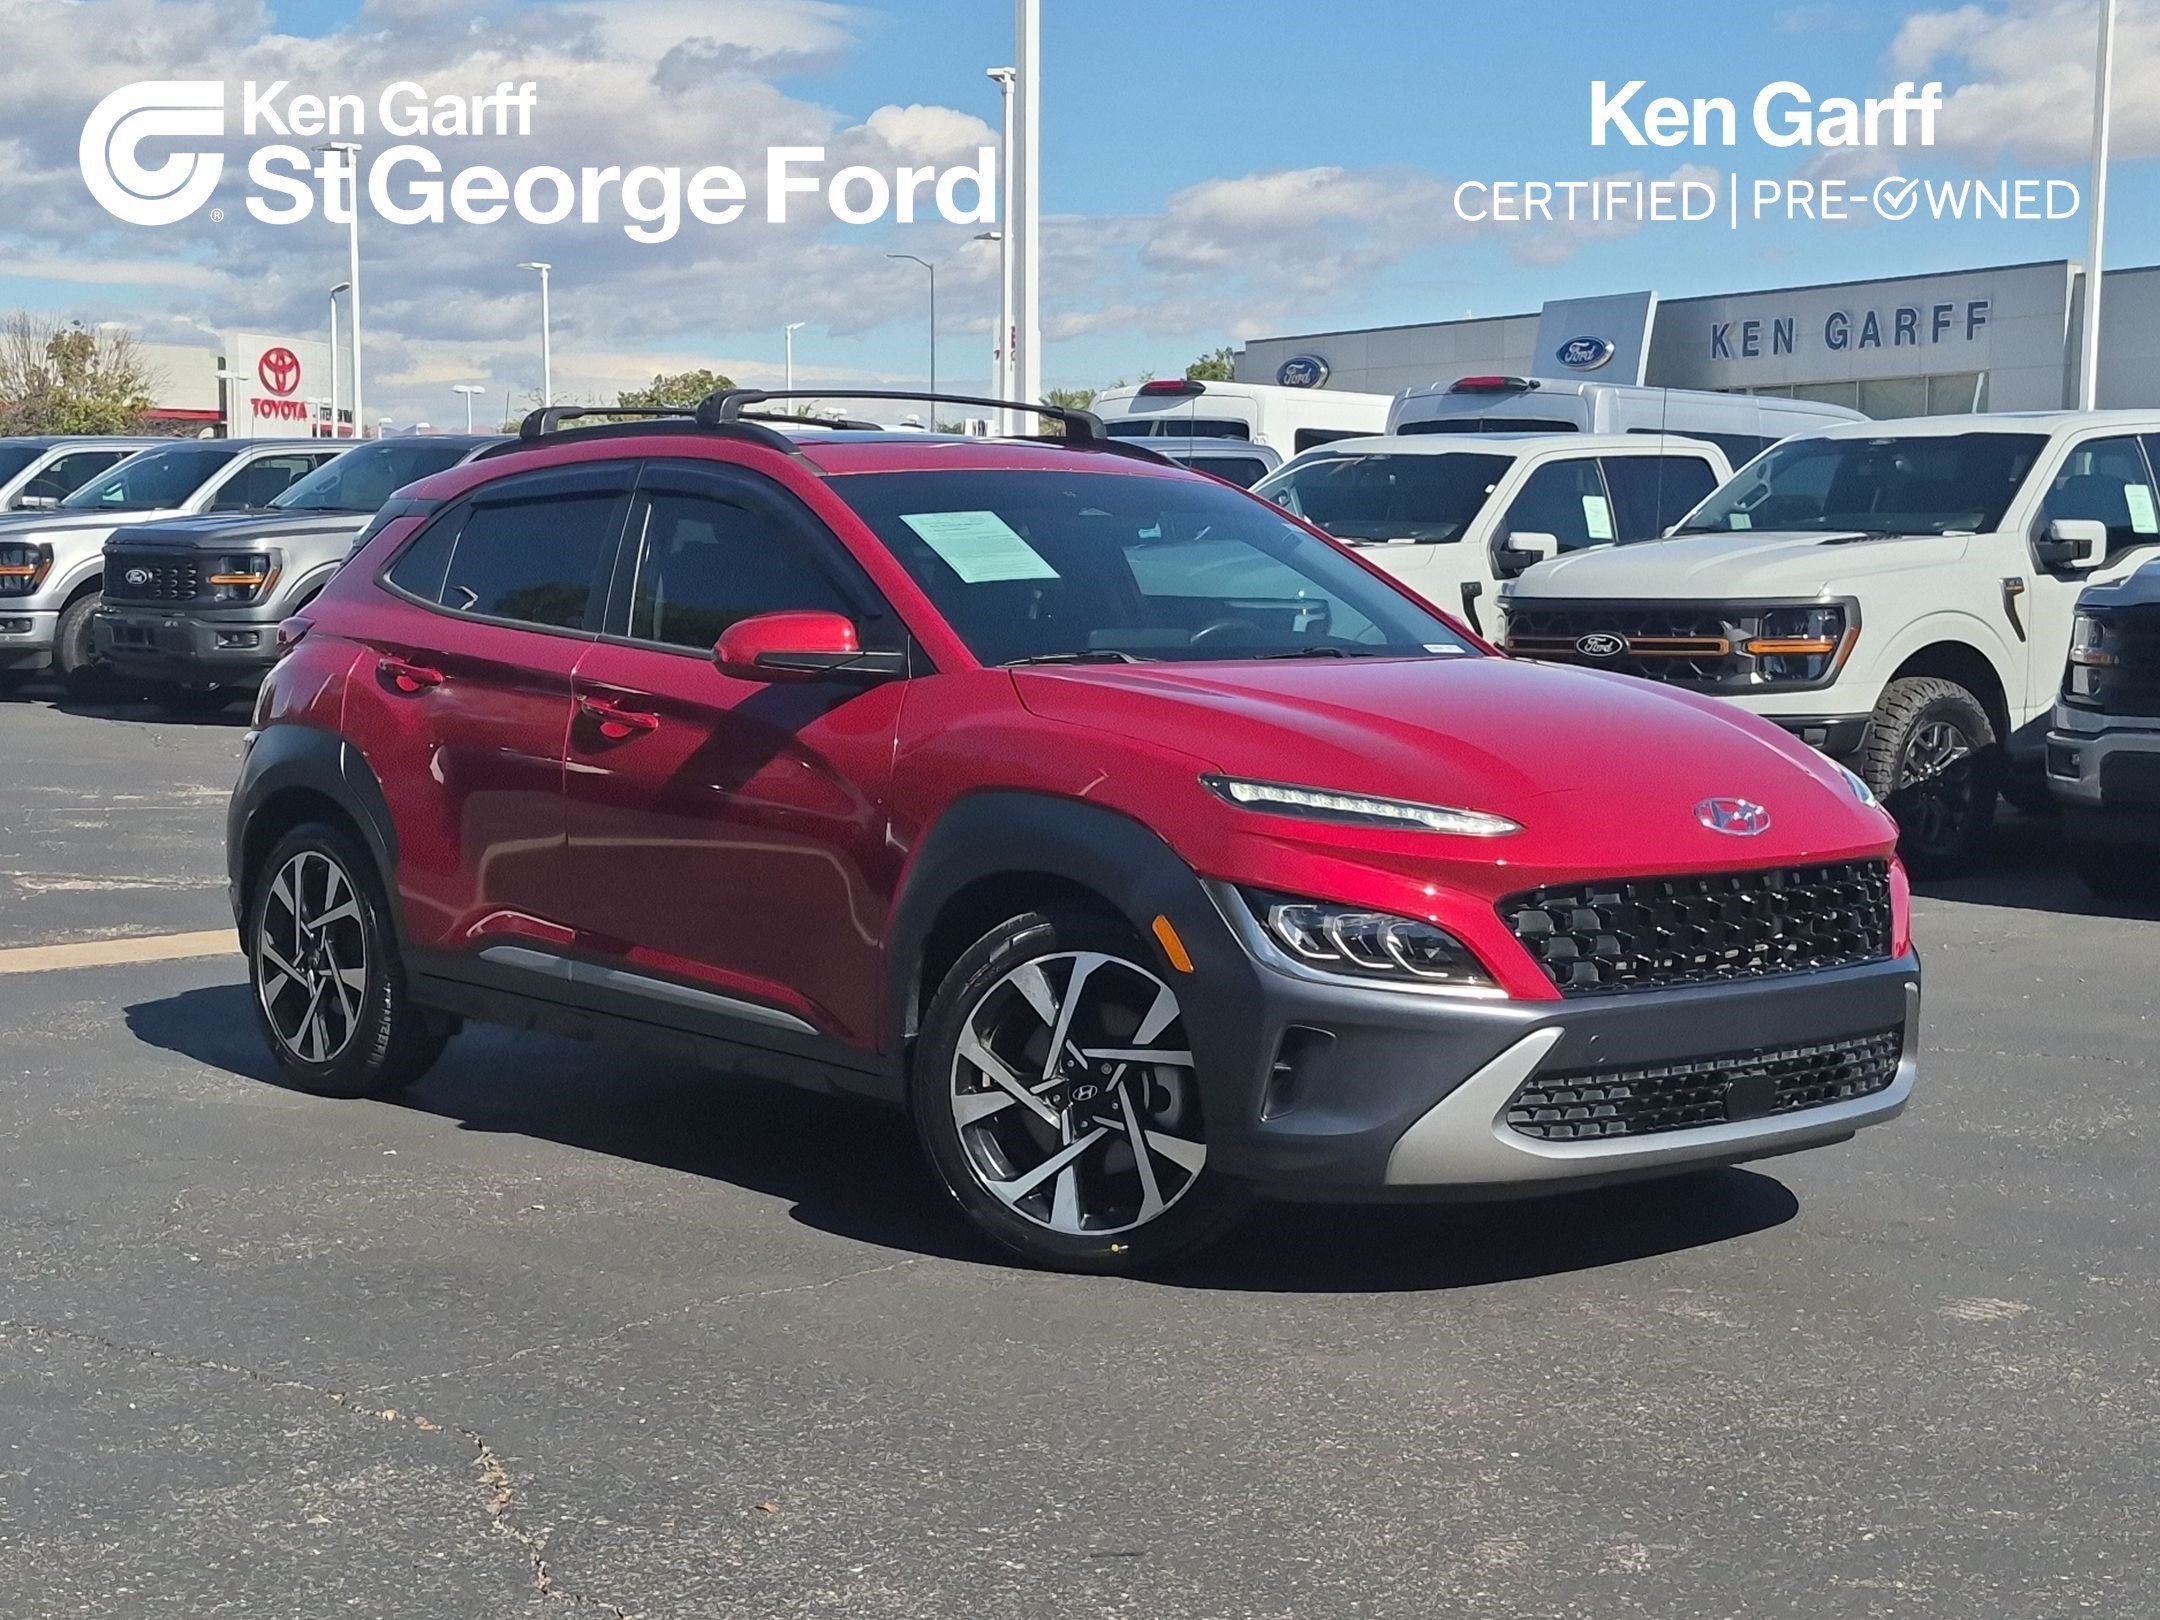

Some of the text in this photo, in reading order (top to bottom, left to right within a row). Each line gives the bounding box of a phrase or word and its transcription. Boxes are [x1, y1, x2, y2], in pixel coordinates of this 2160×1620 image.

[1711, 301, 1989, 358] KEN GARFF
[1565, 342, 1596, 362] Ford
[1284, 364, 1312, 385] Ford
[250, 398, 308, 421] TOYOTA
[1584, 637, 1614, 652] Ford
